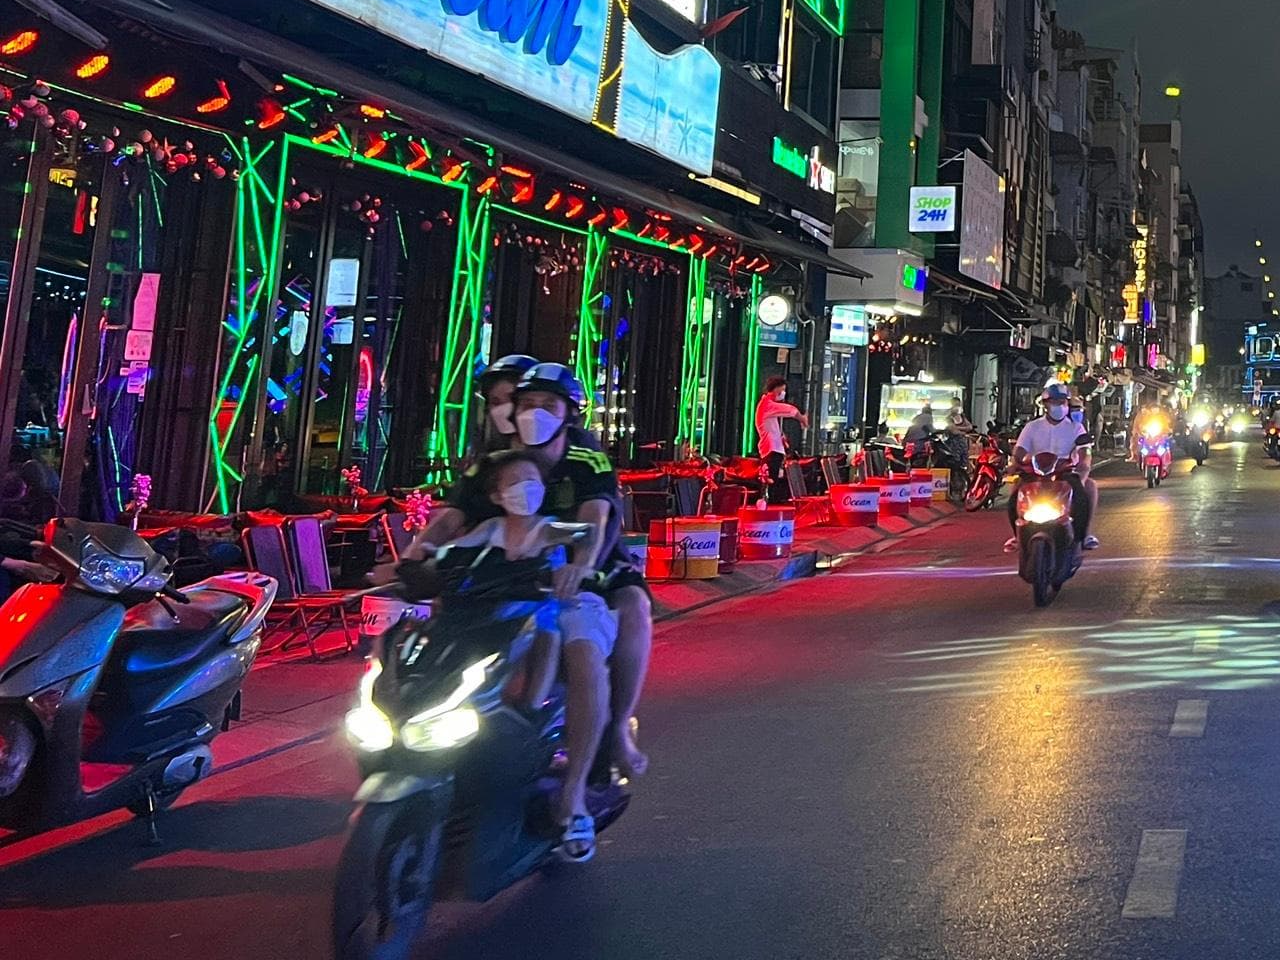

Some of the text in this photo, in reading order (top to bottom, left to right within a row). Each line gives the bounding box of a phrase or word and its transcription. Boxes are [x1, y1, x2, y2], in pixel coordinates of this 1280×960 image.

[914, 197, 952, 209] SHOP
[917, 210, 947, 222] 24H
[842, 495, 871, 506] Ocean
[683, 536, 716, 550] Ocean
